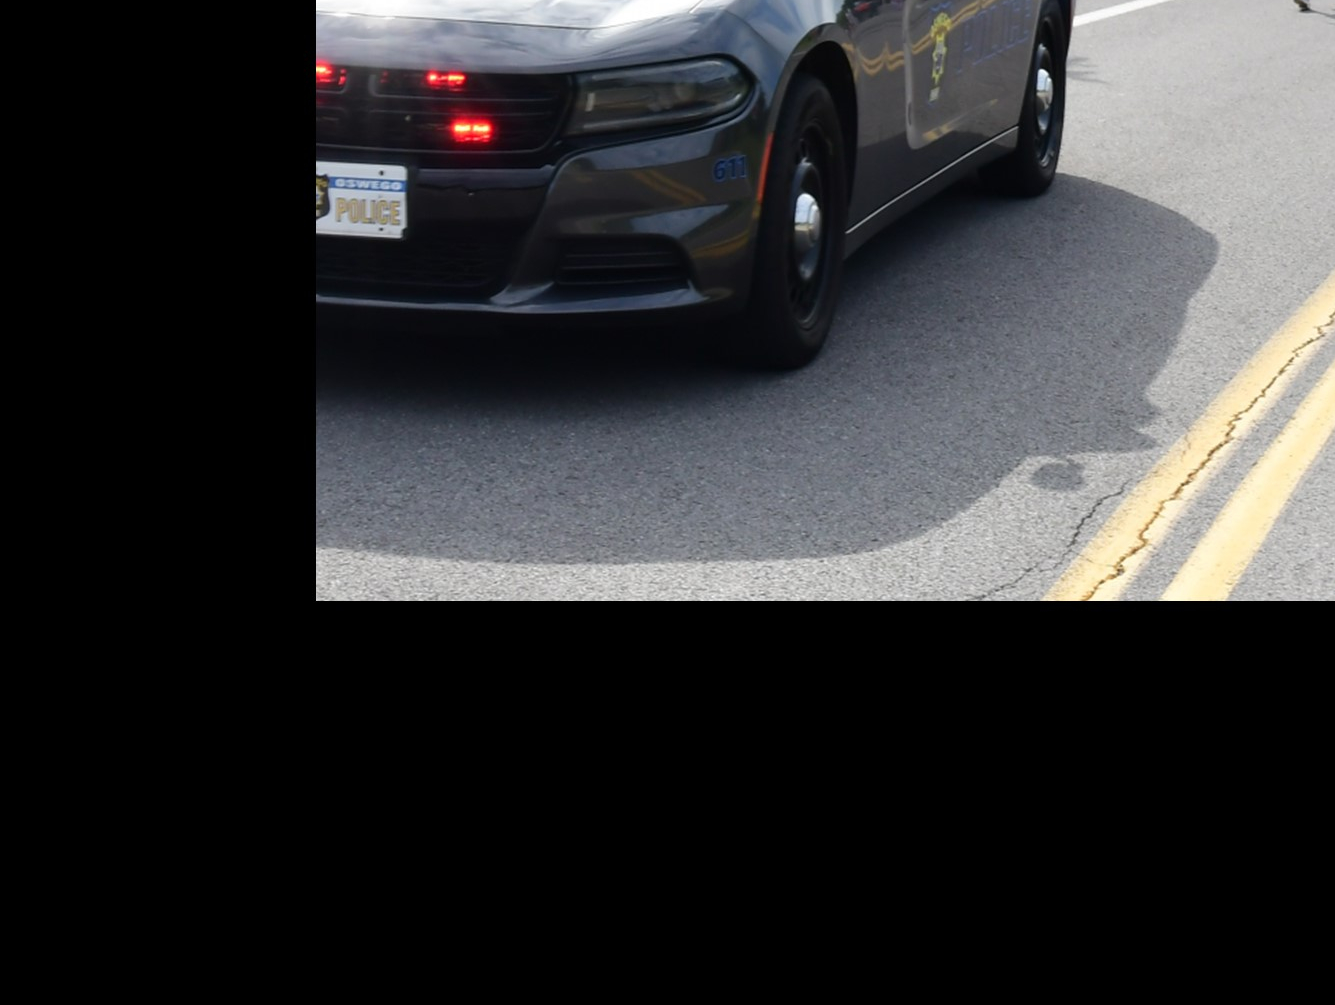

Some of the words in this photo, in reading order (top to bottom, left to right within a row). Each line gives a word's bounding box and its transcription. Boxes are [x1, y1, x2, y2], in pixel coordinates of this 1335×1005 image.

[713, 155, 746, 182] 611
[335, 178, 402, 191] OSWEGO
[335, 197, 401, 226] POLICE
